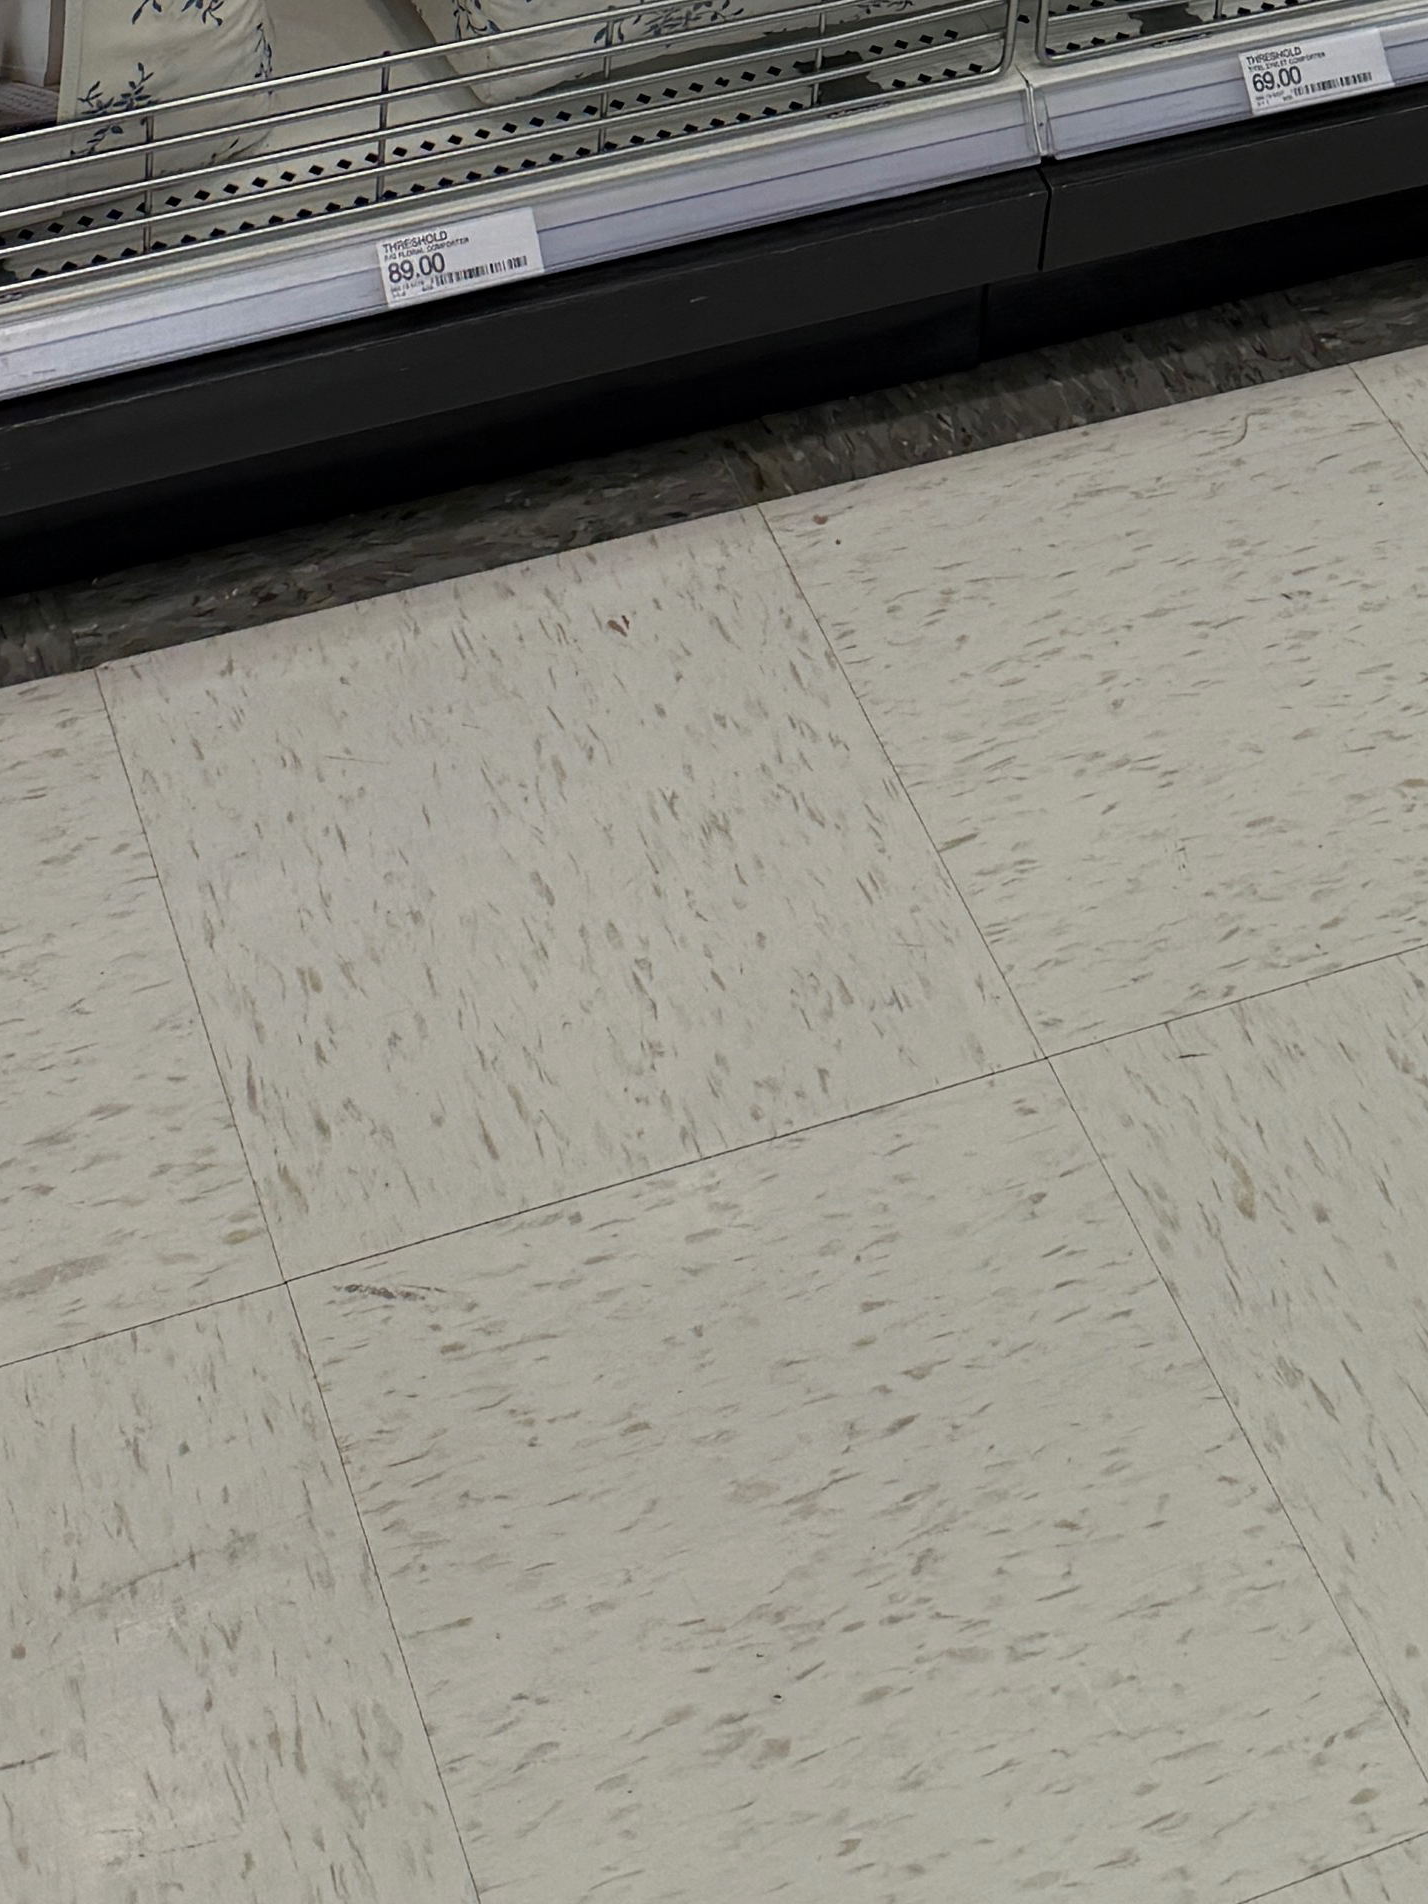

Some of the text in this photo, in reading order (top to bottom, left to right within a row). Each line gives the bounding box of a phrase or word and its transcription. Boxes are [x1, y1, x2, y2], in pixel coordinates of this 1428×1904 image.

[1246, 46, 1302, 65] THRESHOLD
[1252, 66, 1302, 92] 69.00
[383, 230, 448, 253] THRESHOLD
[388, 252, 445, 284] 89.00
